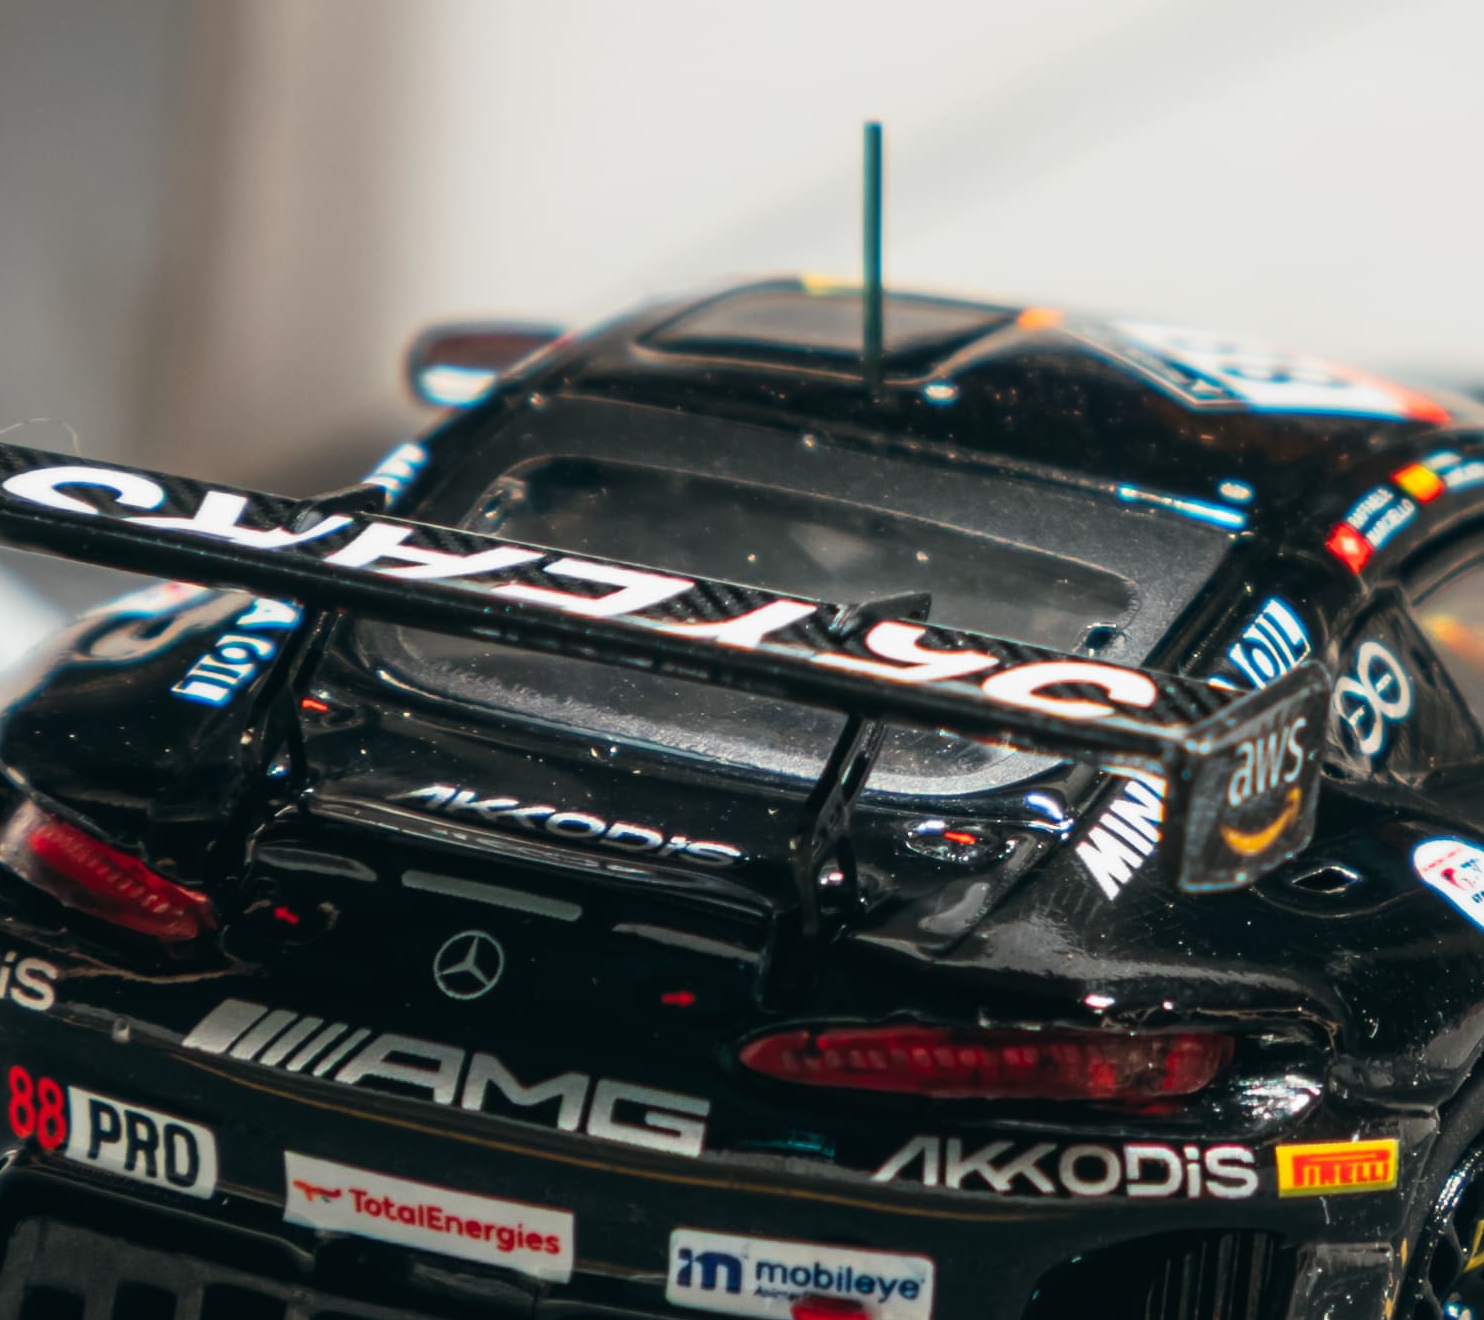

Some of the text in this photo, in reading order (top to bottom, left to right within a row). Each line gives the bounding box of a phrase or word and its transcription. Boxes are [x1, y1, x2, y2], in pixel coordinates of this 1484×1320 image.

[1227, 717, 1308, 807] aws
[8, 1064, 200, 1189] 88 PRO
[1291, 1149, 1391, 1188] PIRELLI
[349, 1187, 561, 1257] TotalEnergies
[755, 1259, 922, 1303] mobileye
